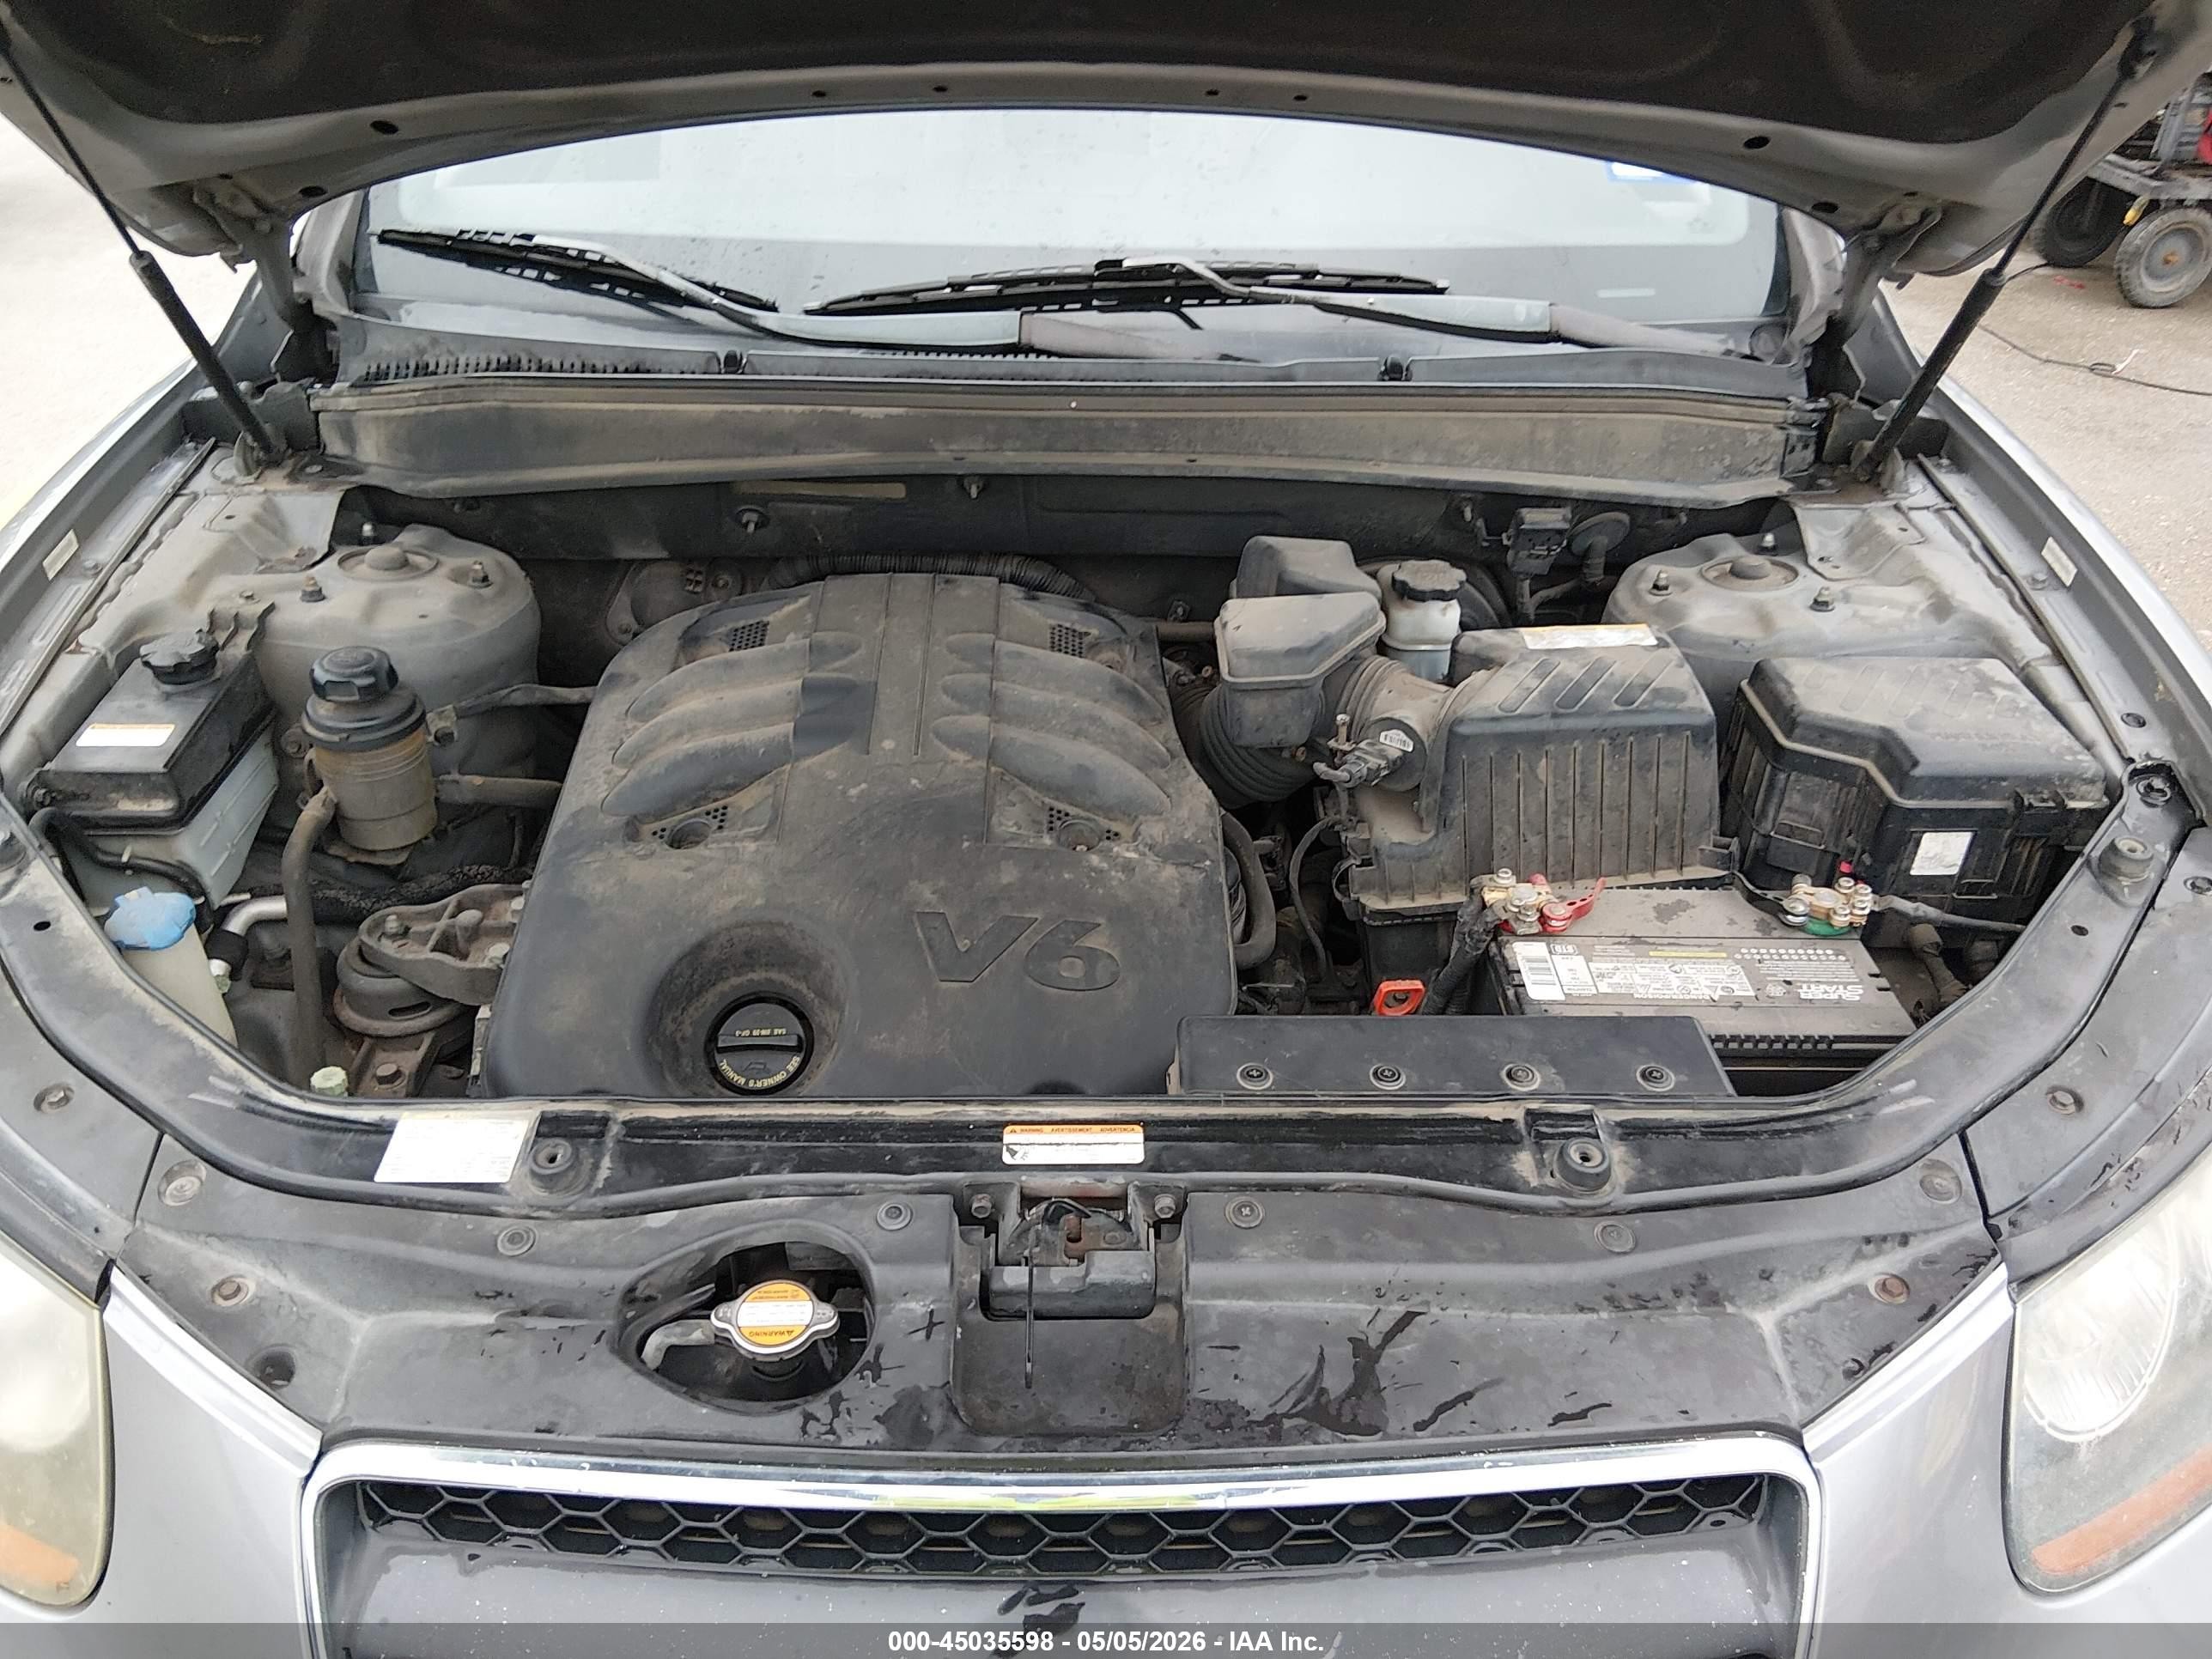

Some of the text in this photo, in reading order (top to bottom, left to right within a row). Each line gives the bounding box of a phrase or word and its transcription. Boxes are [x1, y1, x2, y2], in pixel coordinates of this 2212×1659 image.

[915, 911, 1121, 991] V6
[1797, 983, 1863, 994] START
[1799, 992, 1861, 1001] SUPER
[720, 1059, 746, 1085] MANUAL
[786, 1055, 800, 1073] SEE
